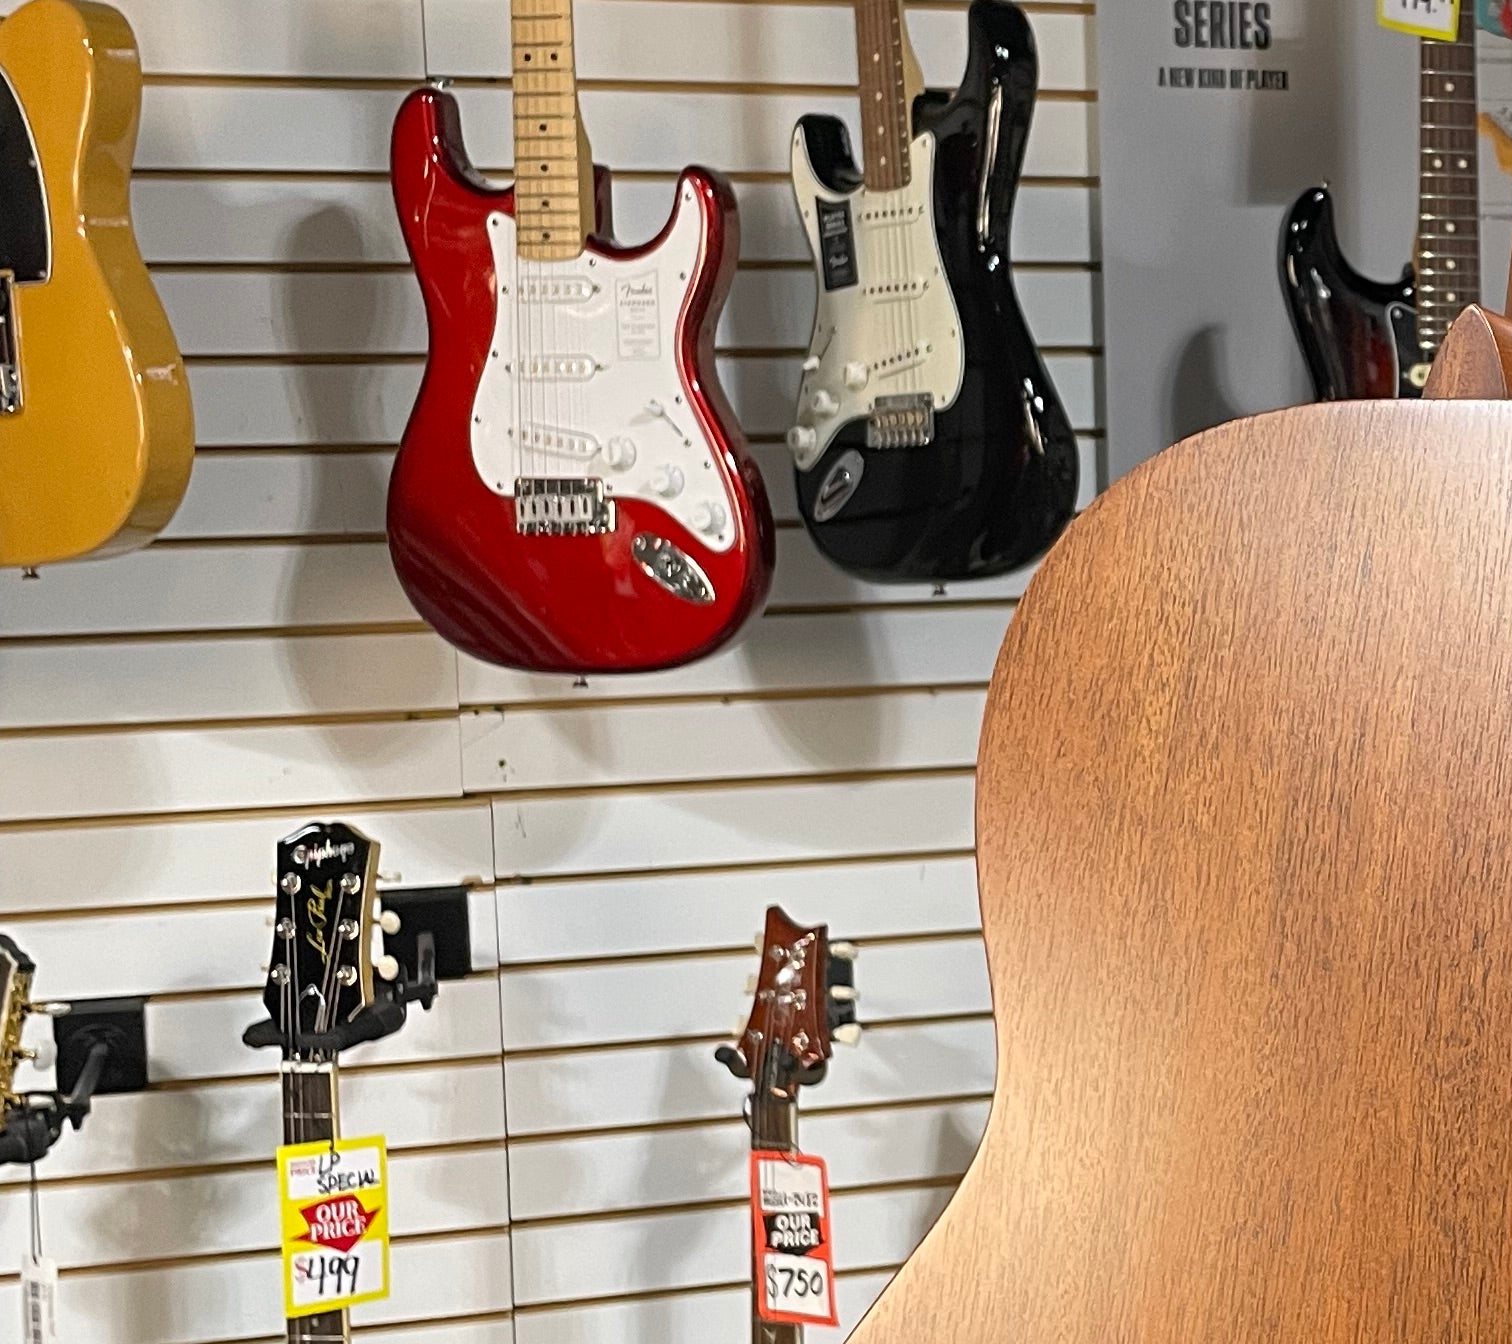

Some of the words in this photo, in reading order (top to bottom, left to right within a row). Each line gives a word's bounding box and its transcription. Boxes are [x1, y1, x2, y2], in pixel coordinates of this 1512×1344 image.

[1173, 0, 1273, 50] SERIES
[1158, 67, 1167, 87] A
[1169, 67, 1196, 88] NEW
[1230, 69, 1245, 89] OF
[1247, 70, 1290, 91] PLAYER
[293, 839, 356, 871] Epiphone
[317, 1150, 342, 1176] LP
[315, 1199, 360, 1223] OUR
[774, 1213, 812, 1232] OUR
[309, 1216, 368, 1243] PRICE
[770, 1229, 821, 1249] PRICE
[767, 1262, 825, 1299] $750
